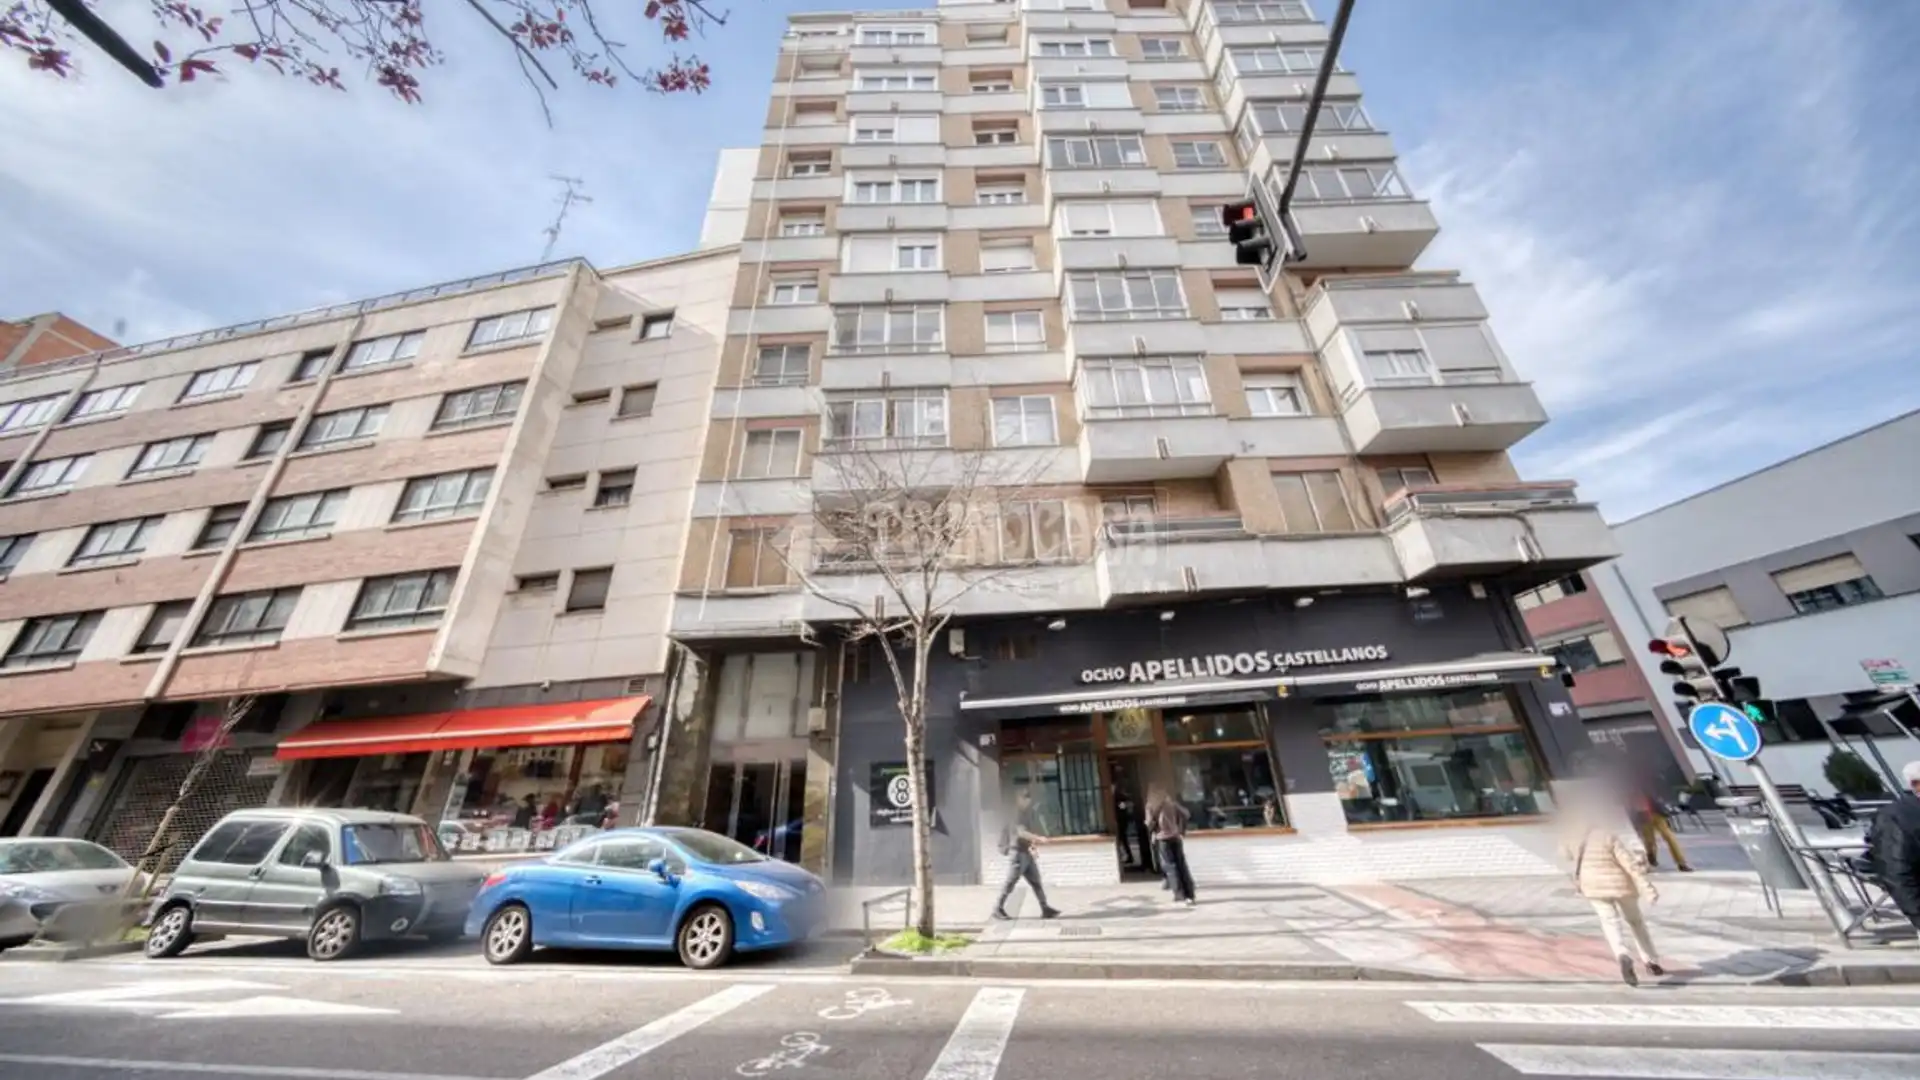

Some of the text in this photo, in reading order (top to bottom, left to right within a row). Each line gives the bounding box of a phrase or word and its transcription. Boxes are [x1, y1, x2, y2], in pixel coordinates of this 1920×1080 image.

[1081, 645, 1388, 683] OCHO APELLIDOS CASTELLANOS
[1379, 674, 1445, 692] APELLIDOS
